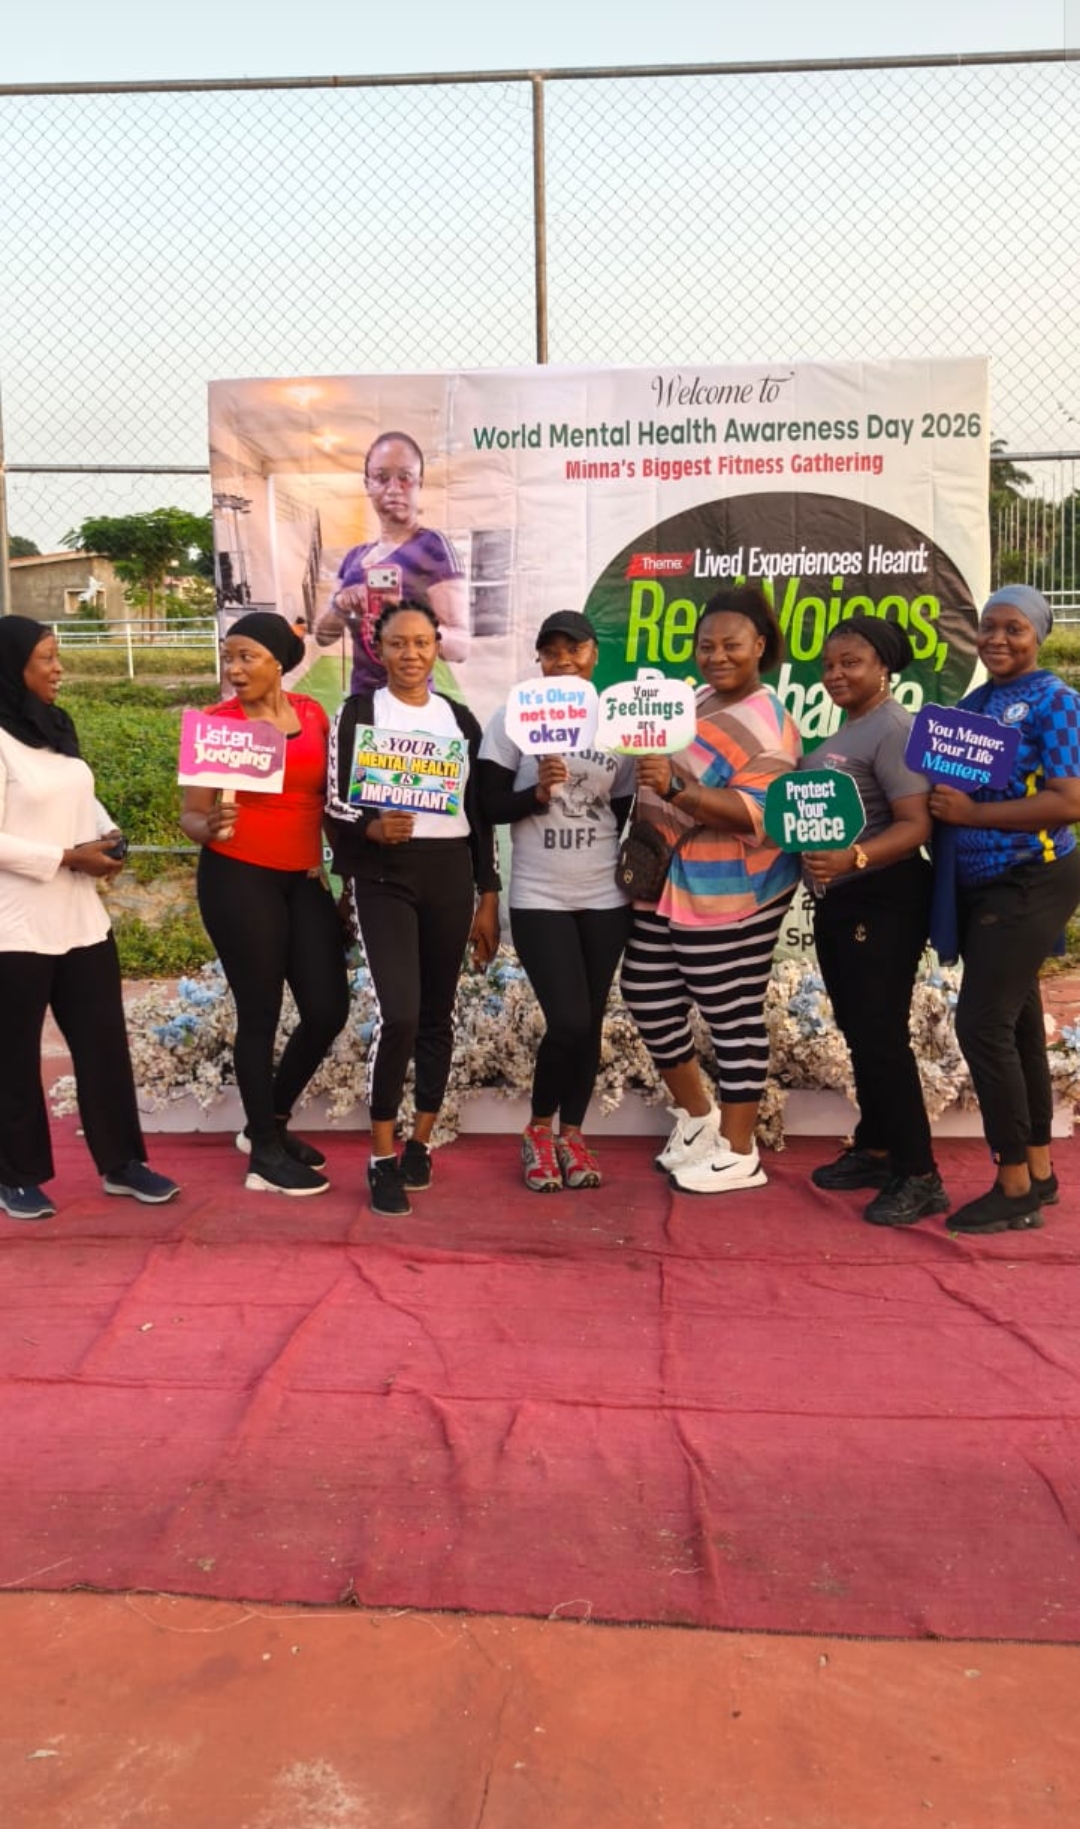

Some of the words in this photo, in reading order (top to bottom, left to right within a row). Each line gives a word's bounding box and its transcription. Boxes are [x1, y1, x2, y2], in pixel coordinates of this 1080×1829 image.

[651, 374, 753, 407] Welcome
[759, 371, 795, 404] to
[474, 422, 542, 450] World
[549, 420, 631, 448] Mental
[638, 417, 716, 446] Health
[724, 418, 860, 443] Awareness
[867, 414, 914, 446] Day
[921, 412, 982, 439] 2026
[566, 459, 635, 480] Minna's
[642, 456, 711, 481] Biggest
[718, 454, 784, 476] Fitness
[790, 452, 884, 476] Gathering
[694, 546, 743, 578] Lived
[749, 546, 862, 583] Experiences
[868, 543, 929, 575] Heard:
[626, 575, 746, 663] Re
[519, 690, 544, 706] It's
[546, 688, 586, 706] Okay
[633, 686, 660, 700] Your
[520, 709, 546, 722] not
[550, 708, 566, 720] to
[568, 704, 587, 719] be
[606, 698, 684, 720] Feelings
[196, 723, 253, 747] Listen
[529, 724, 580, 747] okay
[637, 721, 656, 730] are
[927, 719, 953, 738] You
[389, 737, 436, 756] YOUR
[621, 729, 667, 748] valid
[194, 743, 272, 771] Judging
[931, 737, 965, 757] Your
[966, 746, 994, 765] Life
[358, 751, 408, 772] MENTAL
[411, 757, 461, 778] HEALTH
[922, 751, 992, 784] Matters
[361, 782, 452, 811] IMPORTANT
[785, 779, 836, 800] Protect
[797, 800, 828, 818] Your
[544, 827, 596, 850] BUFF
[783, 812, 846, 844] Peace
